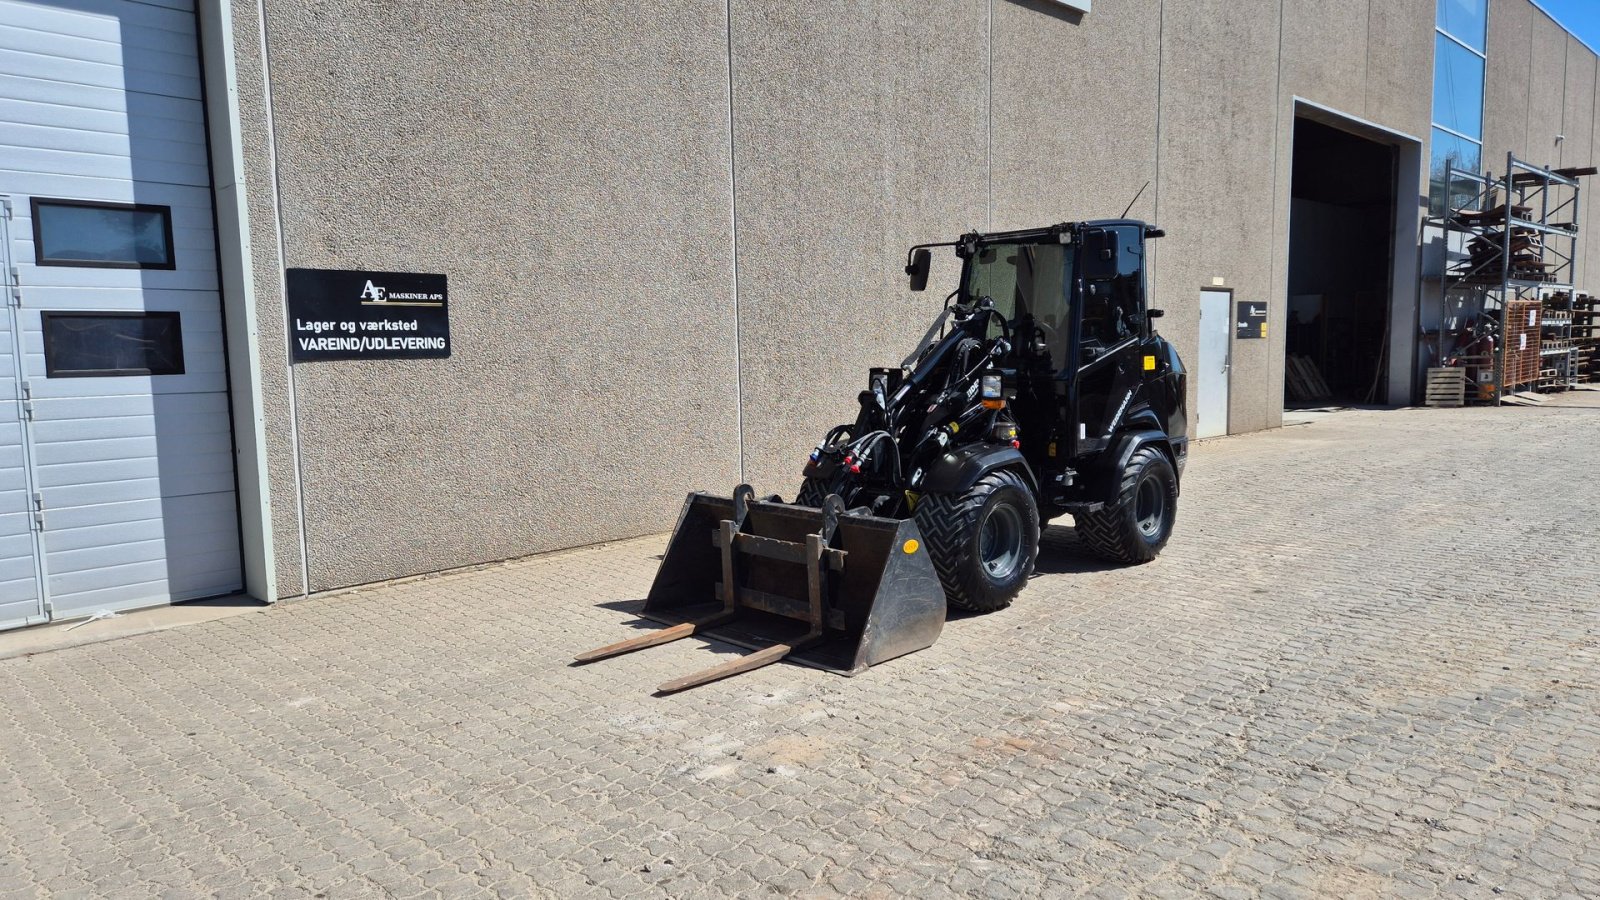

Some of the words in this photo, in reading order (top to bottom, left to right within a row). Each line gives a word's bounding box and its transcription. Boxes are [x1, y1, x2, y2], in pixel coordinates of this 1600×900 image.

[360, 279, 386, 302] AE
[389, 292, 428, 300] MASKINER
[296, 318, 336, 333] Lager
[340, 321, 356, 333] og
[359, 319, 418, 331] værksted
[299, 336, 445, 352] VAREIND/UDLEVERING
[1108, 389, 1132, 433] WEIDEMANN
